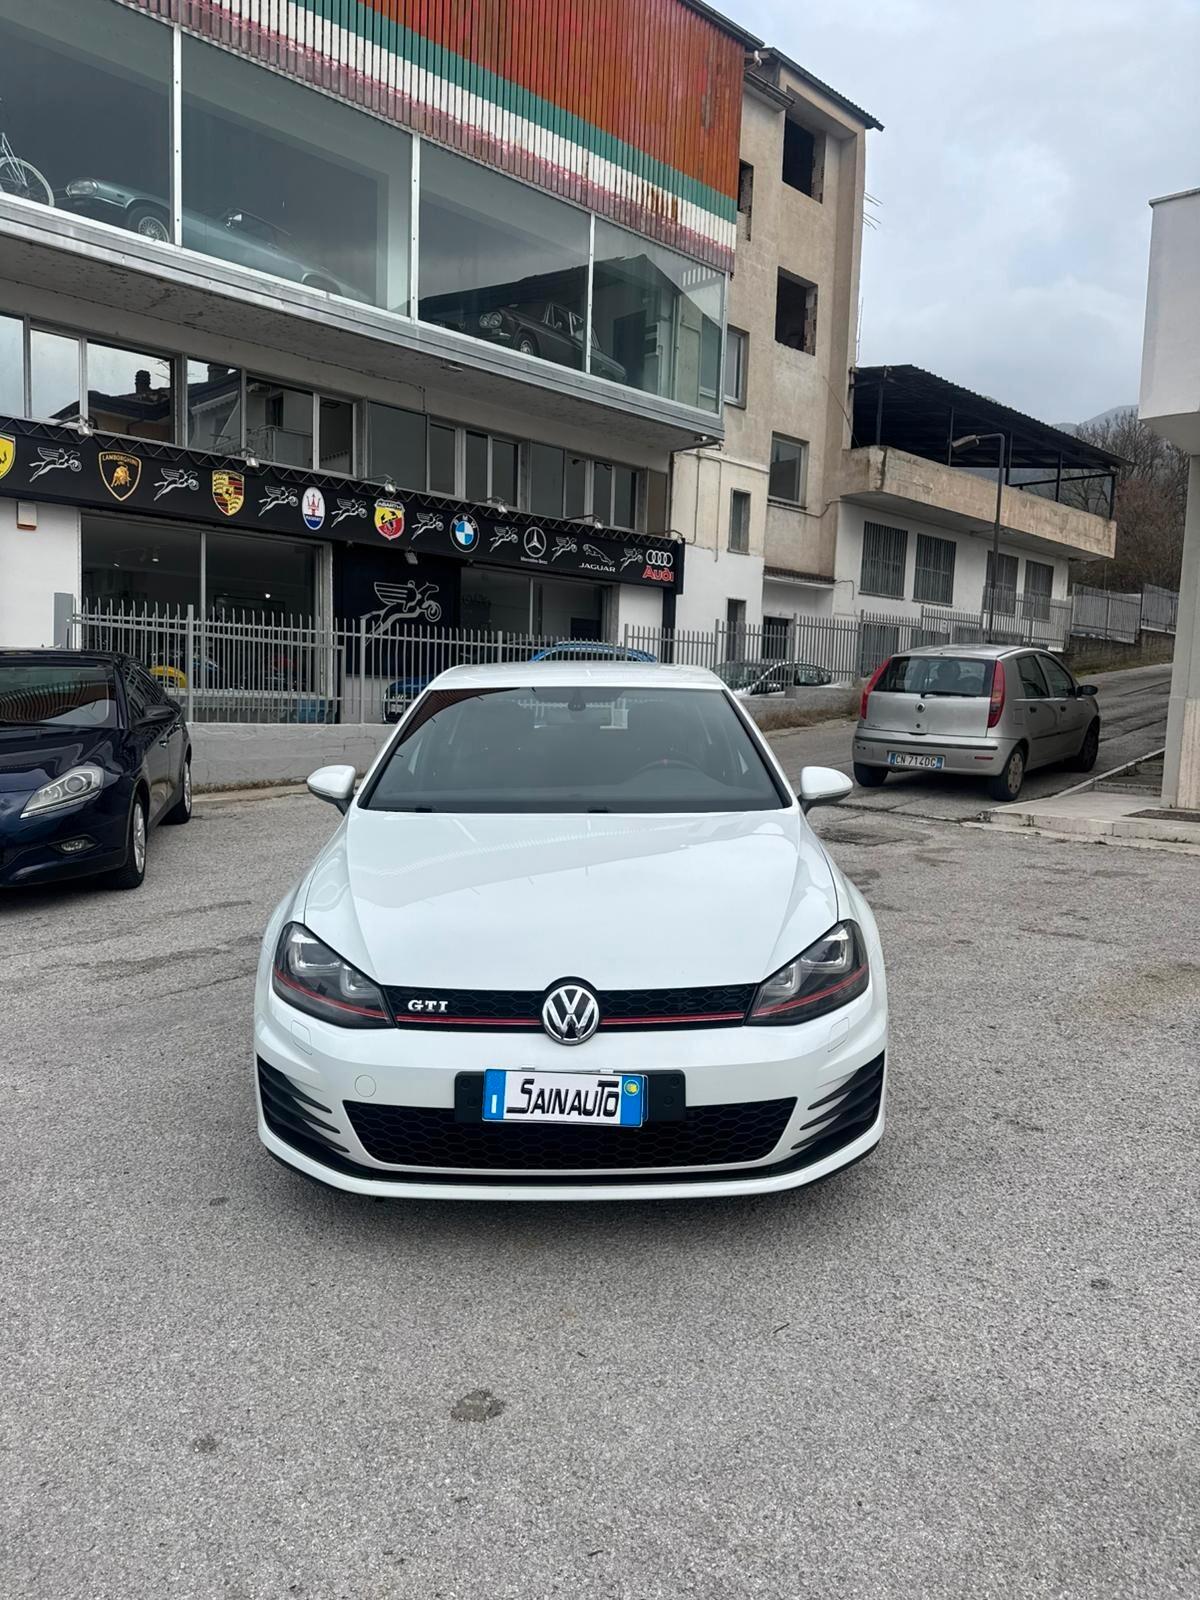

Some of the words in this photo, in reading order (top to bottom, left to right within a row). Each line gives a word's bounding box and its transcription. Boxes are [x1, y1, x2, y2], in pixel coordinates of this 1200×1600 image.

[579, 562, 616, 573] JAGUAR
[642, 565, 675, 582] Audi
[895, 755, 906, 764] CN
[407, 999, 448, 1013] GTI
[506, 1078, 620, 1117] SAINAUTO
